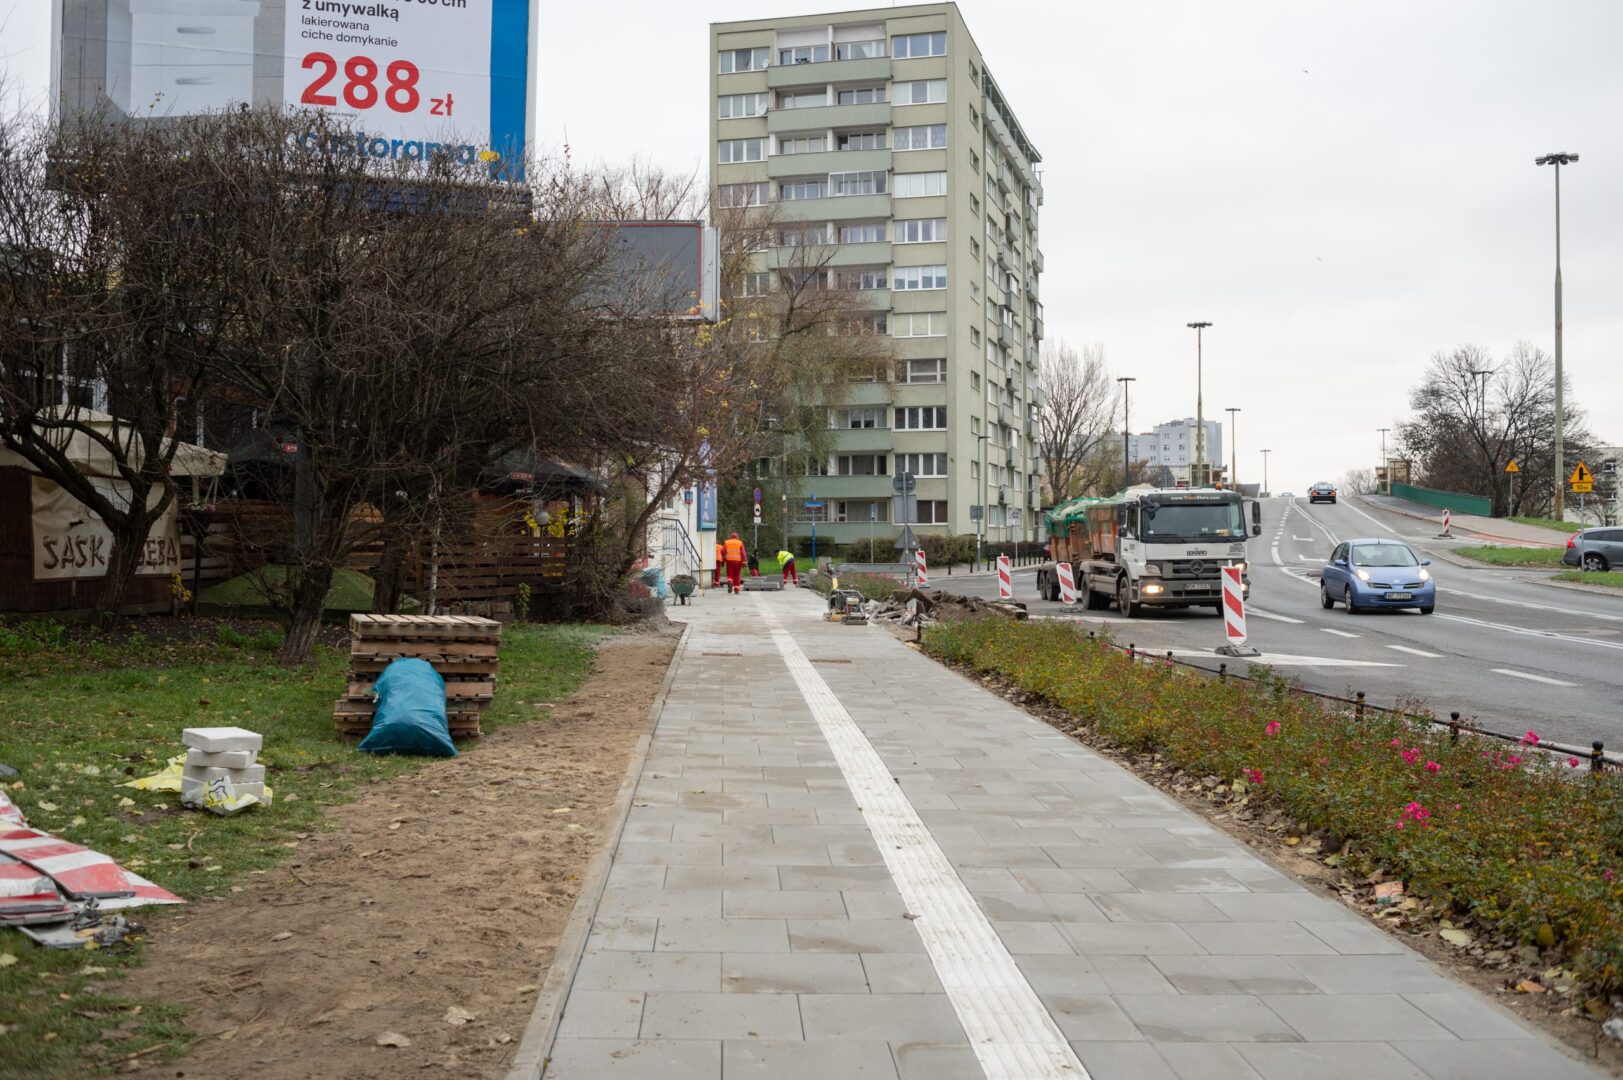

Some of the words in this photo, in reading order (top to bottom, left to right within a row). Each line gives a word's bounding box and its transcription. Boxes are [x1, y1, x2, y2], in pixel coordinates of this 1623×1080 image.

[302, 0, 311, 10] z
[315, 0, 399, 22] umywalką
[442, 0, 466, 8] cm
[302, 15, 370, 31] lakierowana
[301, 29, 333, 41] ciche
[336, 32, 398, 47] domykanie
[301, 52, 420, 113] 288
[430, 93, 454, 116] zł
[43, 535, 110, 569] SASK
